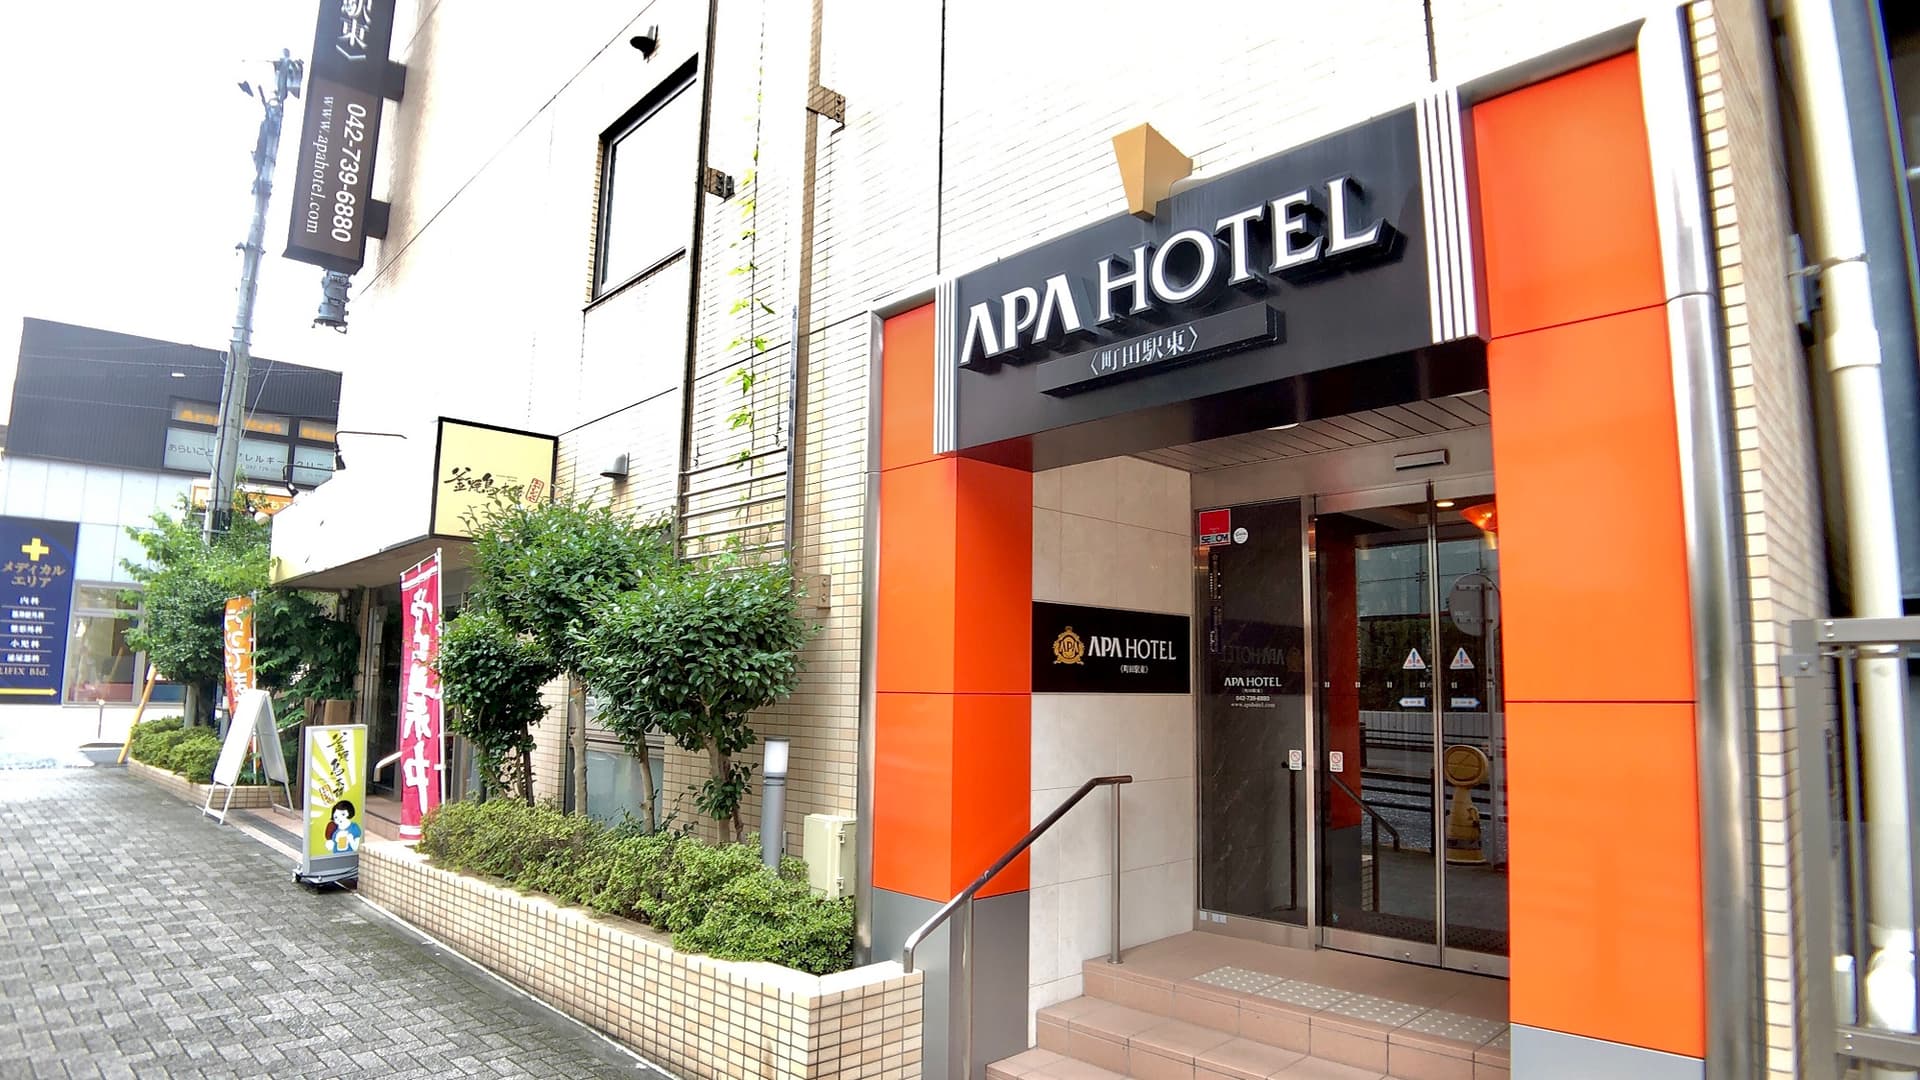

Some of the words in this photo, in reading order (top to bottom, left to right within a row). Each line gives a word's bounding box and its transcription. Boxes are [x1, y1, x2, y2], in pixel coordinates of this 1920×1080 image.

[306, 96, 334, 234] www.apahotel.com
[331, 103, 367, 242] 042-739-6880
[959, 272, 1084, 367] APA
[1094, 175, 1384, 326] HOTEL
[1089, 326, 1200, 376] 〈町田駅東〉
[2, 561, 66, 576] メディカル
[11, 575, 51, 588] エリア
[1088, 636, 1123, 658] APA
[1125, 638, 1177, 660] HOTEL
[1224, 677, 1245, 687] APA
[1246, 677, 1282, 687] HOTEL
